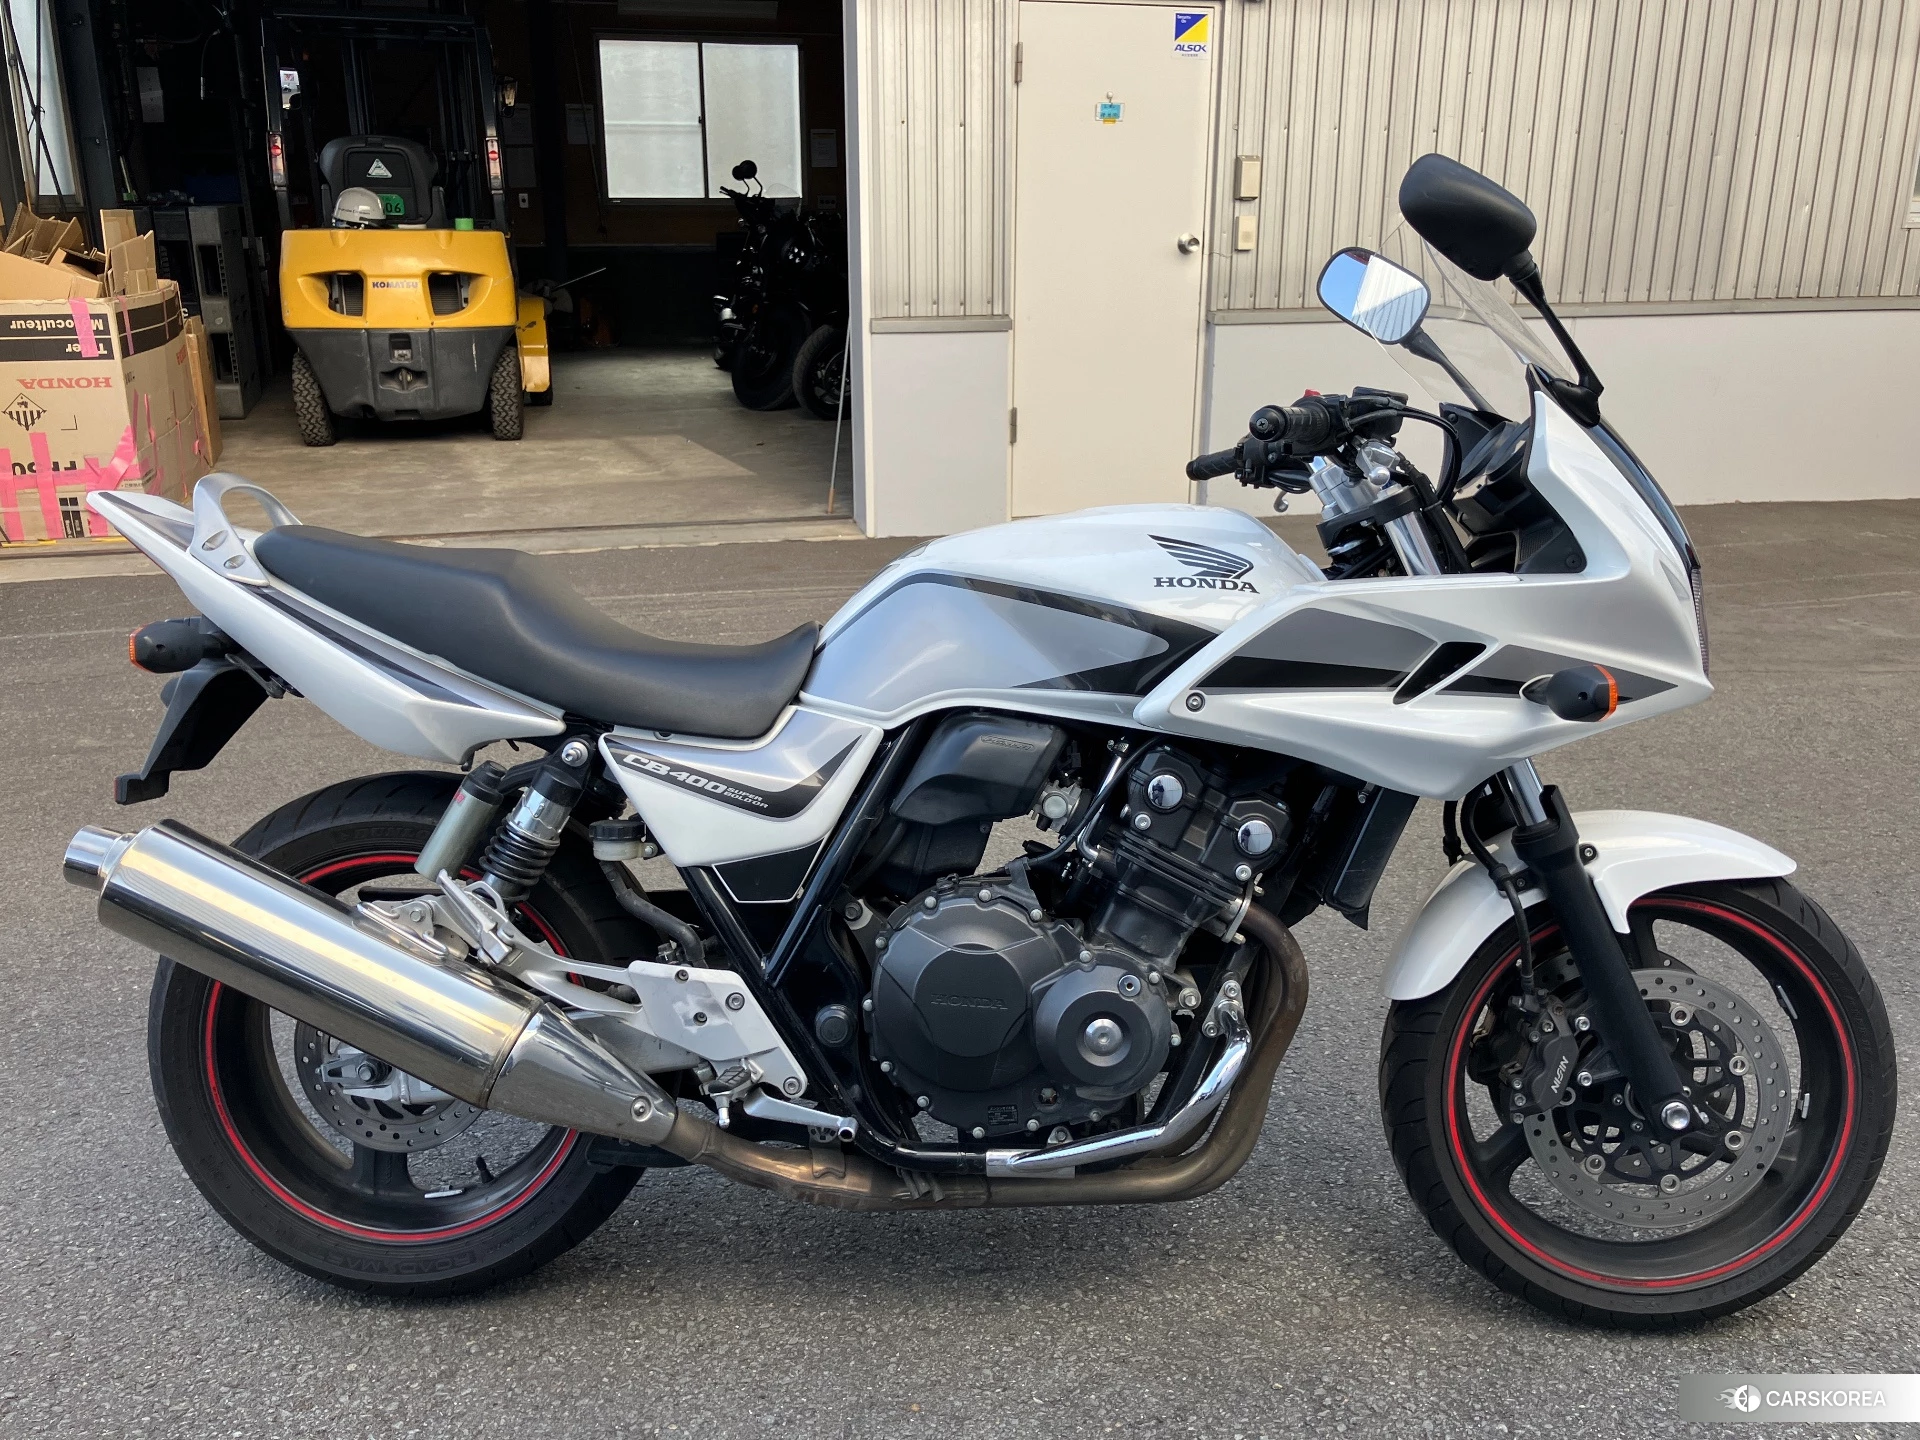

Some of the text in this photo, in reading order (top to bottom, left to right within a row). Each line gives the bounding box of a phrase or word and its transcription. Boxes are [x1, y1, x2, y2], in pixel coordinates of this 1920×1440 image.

[1174, 44, 1207, 52] ALSOK
[383, 202, 402, 213] 06
[371, 281, 419, 289] KOMATSU
[10, 319, 104, 331] Moculteur
[65, 343, 108, 355] Ter
[17, 377, 112, 390] HONDA
[1153, 577, 1260, 594] HONDA
[622, 754, 728, 795] CB400
[726, 787, 763, 802] SUPER
[930, 993, 1009, 1010] HONDA
